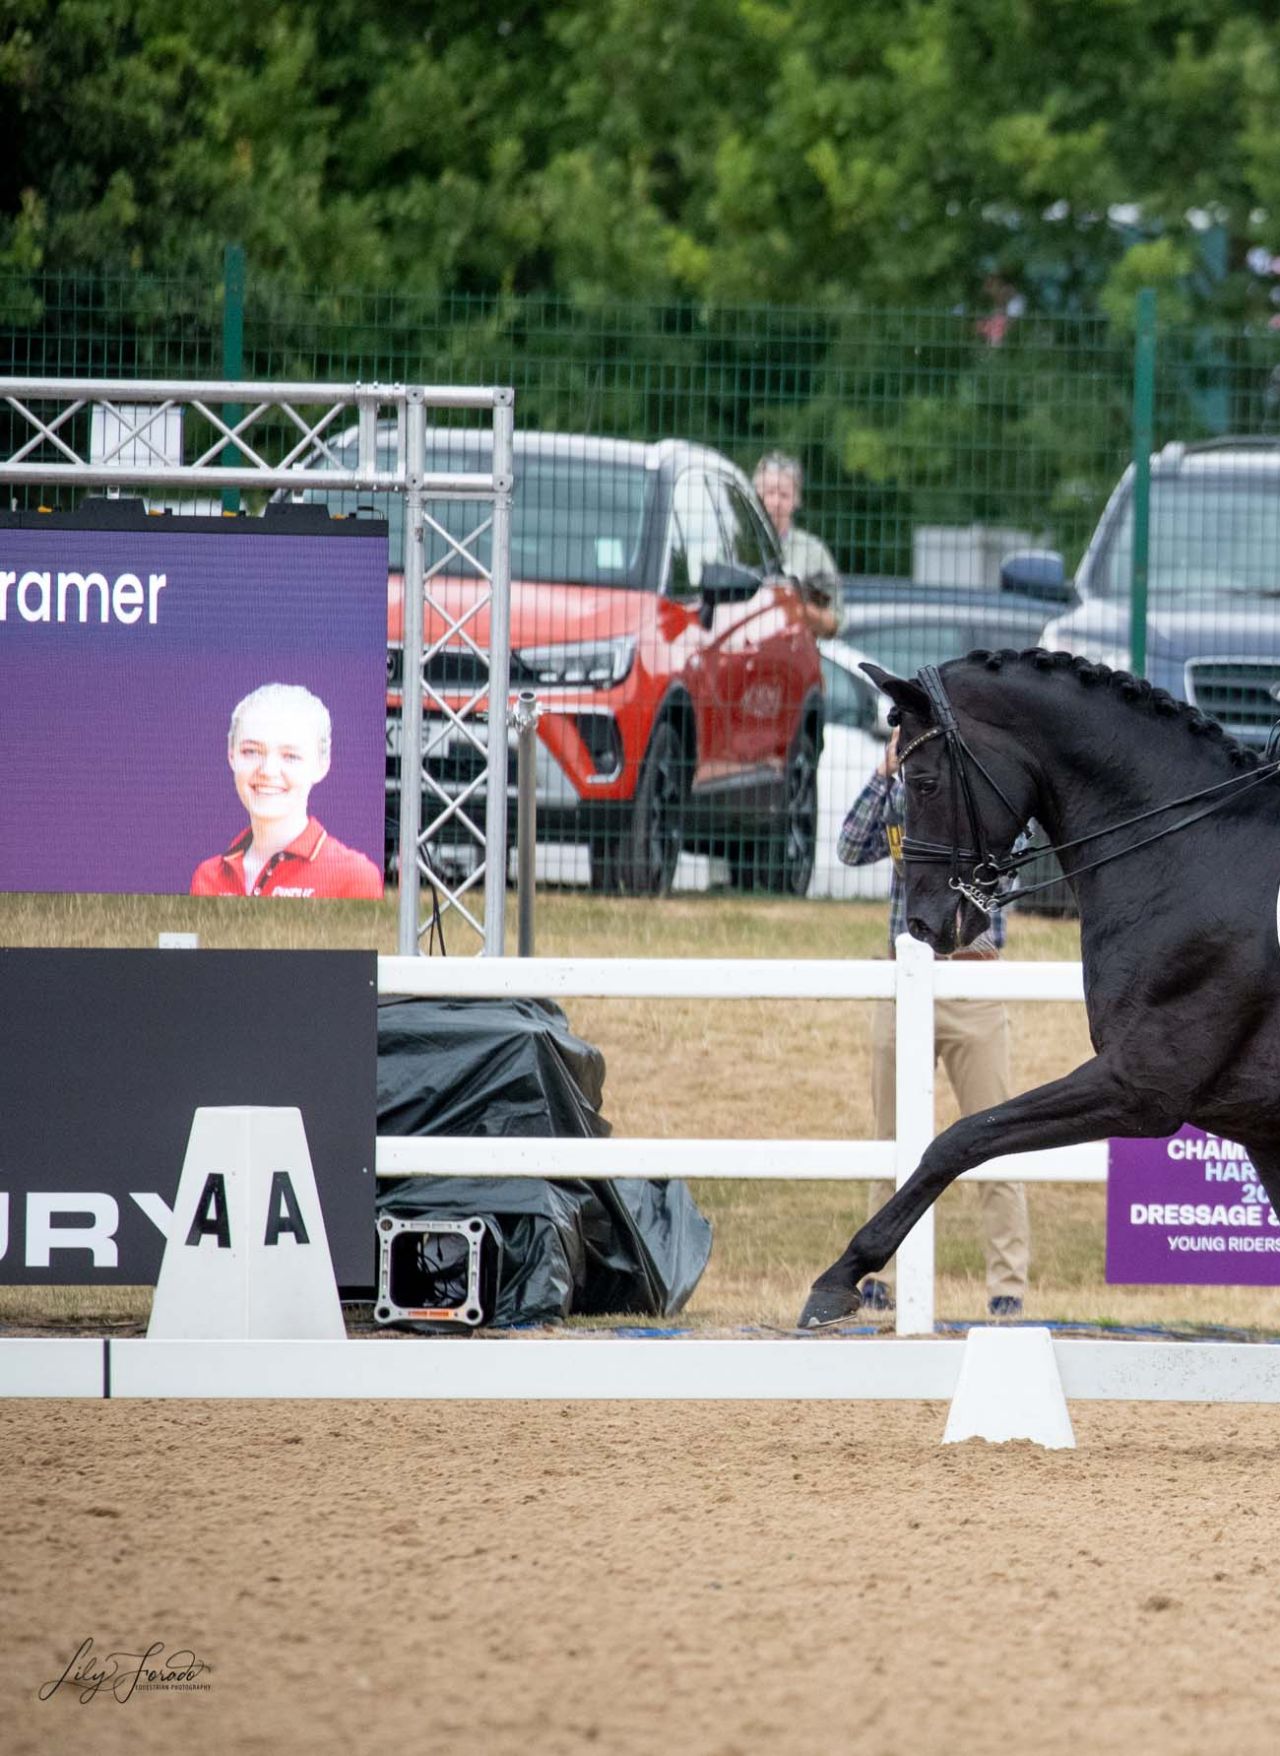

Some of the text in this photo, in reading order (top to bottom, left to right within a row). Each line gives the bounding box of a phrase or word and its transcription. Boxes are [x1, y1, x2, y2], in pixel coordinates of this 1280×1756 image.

[185, 1172, 231, 1248] A
[264, 1171, 311, 1246] A
[1130, 1203, 1263, 1226] DRESSAGE
[1168, 1236, 1226, 1252] YOUNG
